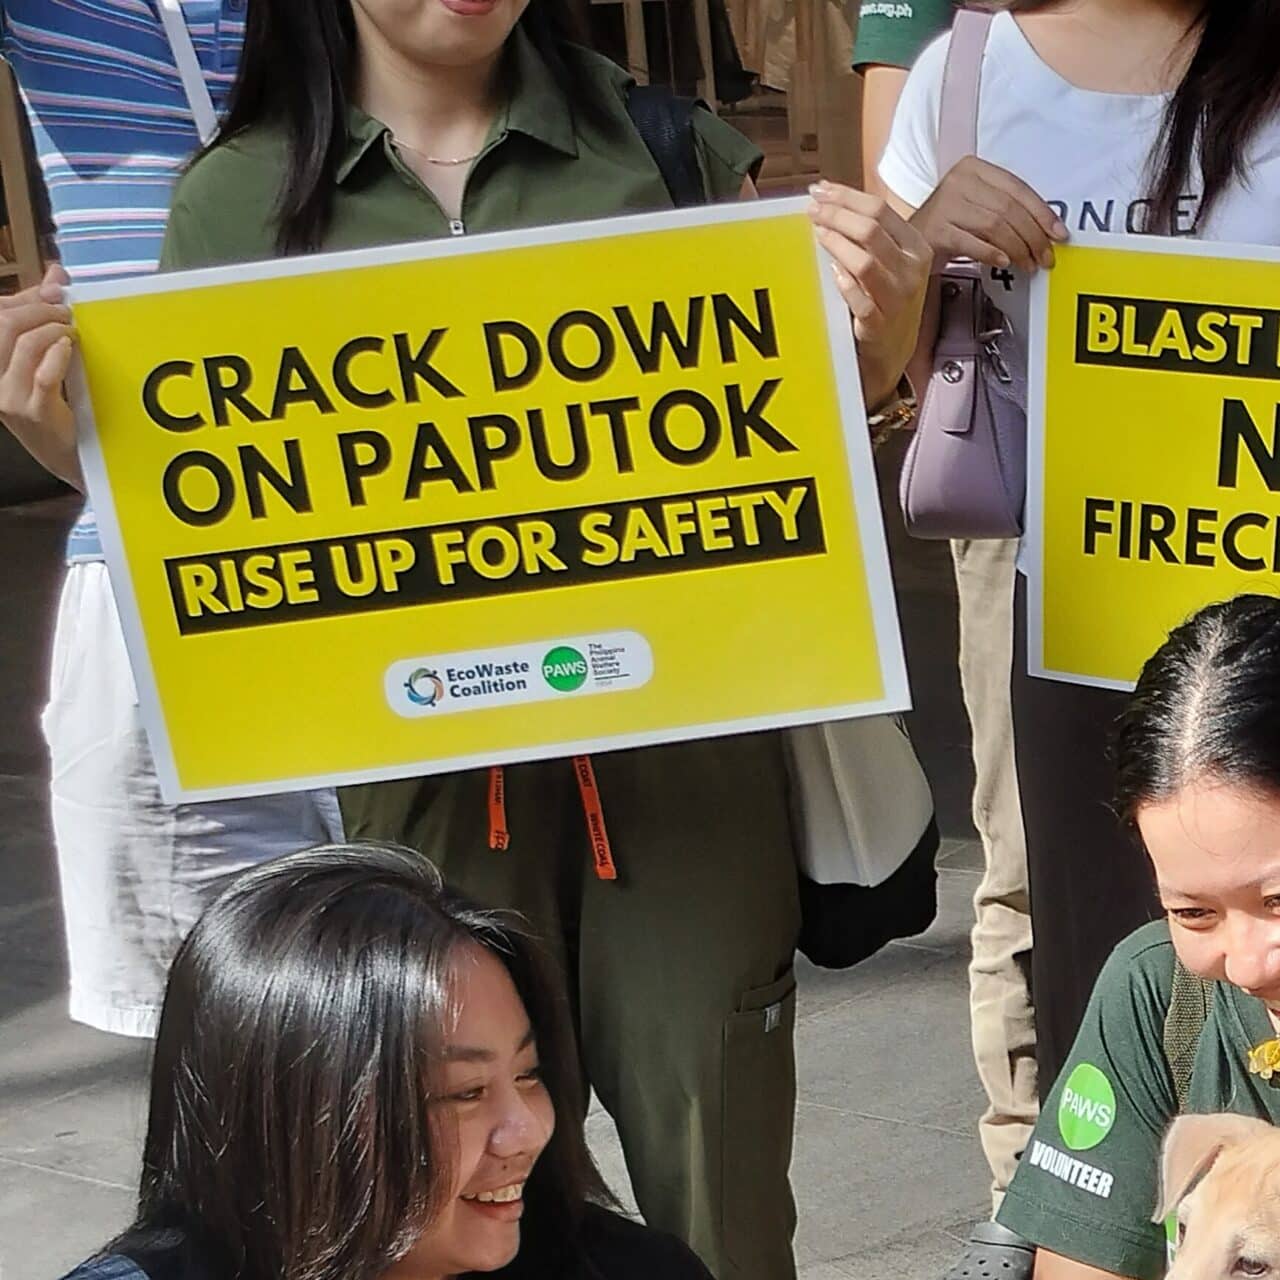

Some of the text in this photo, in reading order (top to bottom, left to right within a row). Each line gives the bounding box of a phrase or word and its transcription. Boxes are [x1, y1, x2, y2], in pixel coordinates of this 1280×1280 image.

[142, 288, 780, 433] CRACK DOWN
[1086, 302, 1264, 367] BLAST
[162, 378, 799, 527] ON PAPUTOK
[180, 487, 810, 618] RISE UP FOR SAFETY
[446, 661, 530, 682] EcoWaste
[450, 677, 527, 698] Coalition
[544, 661, 587, 679] PAWS
[1061, 1087, 1112, 1128] PAWS
[1030, 1140, 1114, 1199] VOLUNTEER
